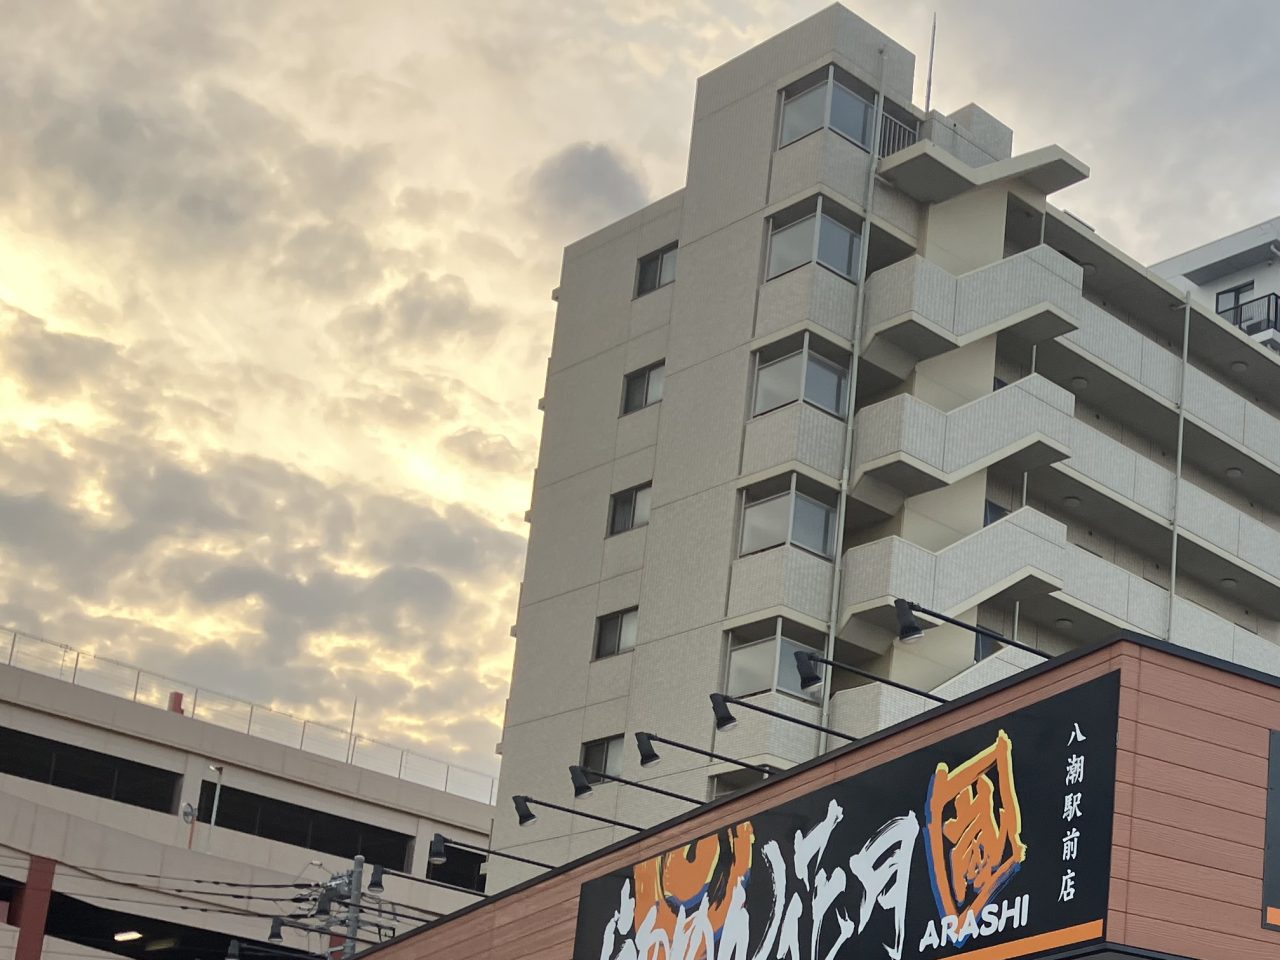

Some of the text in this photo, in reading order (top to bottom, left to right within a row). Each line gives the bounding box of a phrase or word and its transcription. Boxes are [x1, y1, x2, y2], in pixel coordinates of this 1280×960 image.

[1058, 722, 1087, 902] 八潮駅前店
[918, 893, 1030, 953] ARASHI
